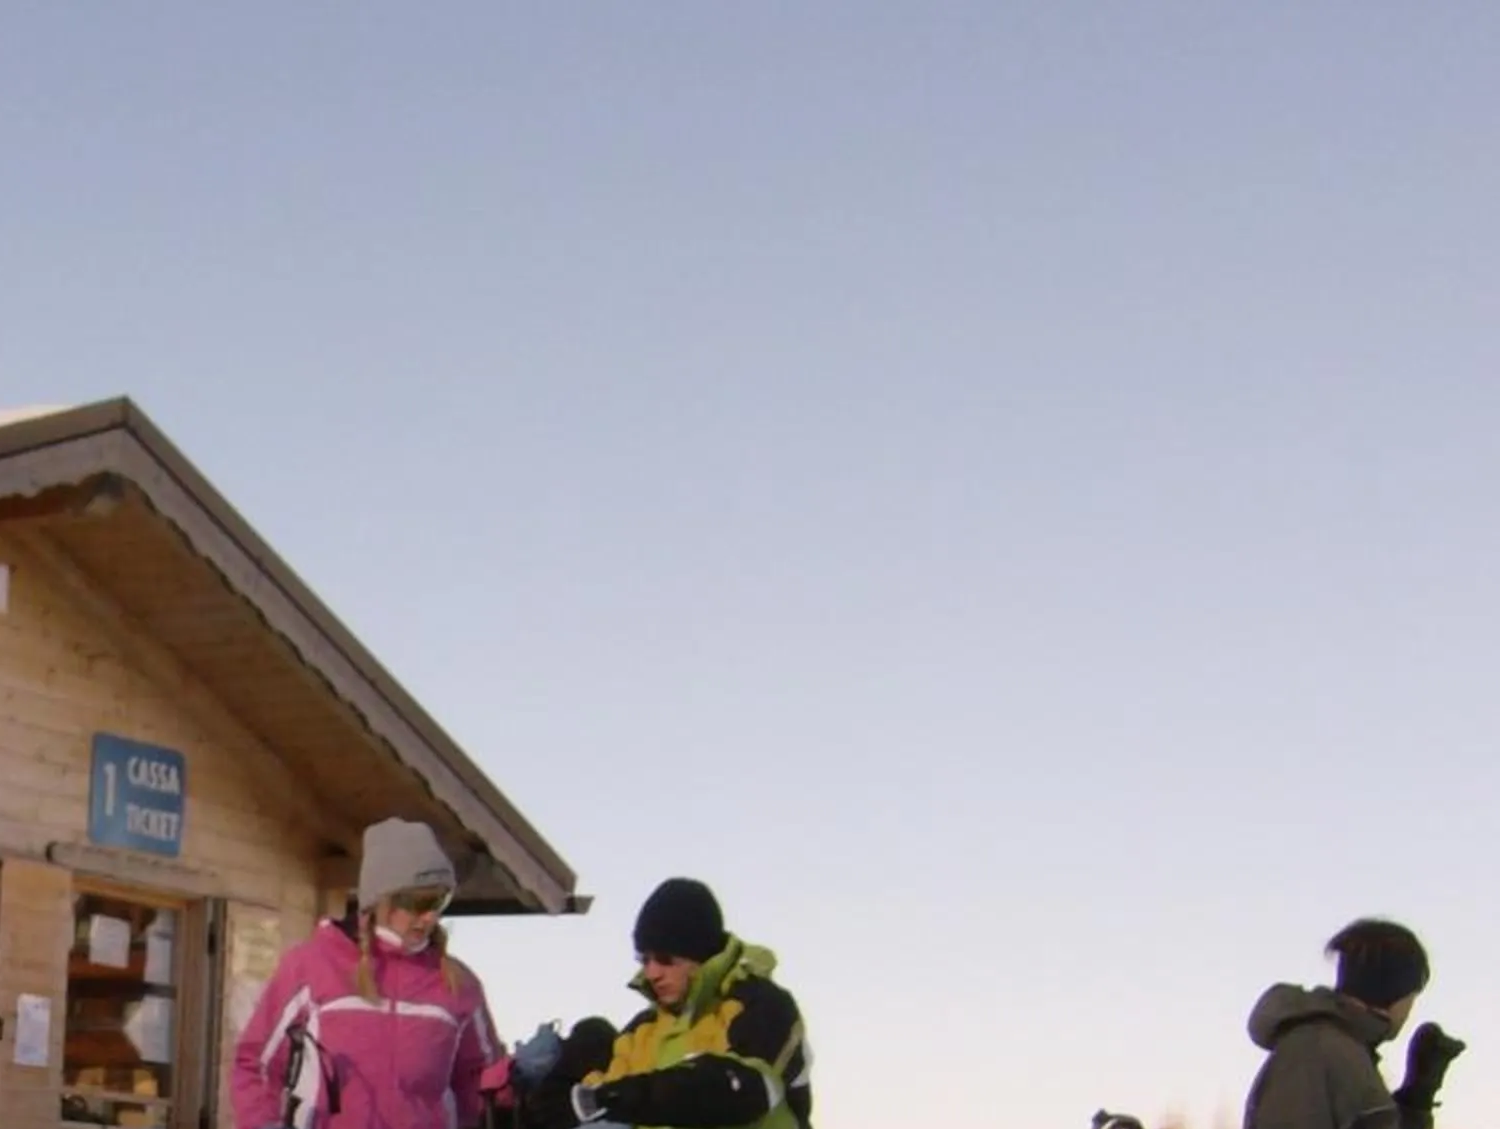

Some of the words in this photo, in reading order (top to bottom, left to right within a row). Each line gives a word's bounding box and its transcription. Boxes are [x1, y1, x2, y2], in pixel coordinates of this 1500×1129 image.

[104, 762, 117, 817] 1
[127, 755, 182, 795] CASSA
[126, 801, 181, 842] TICKET
